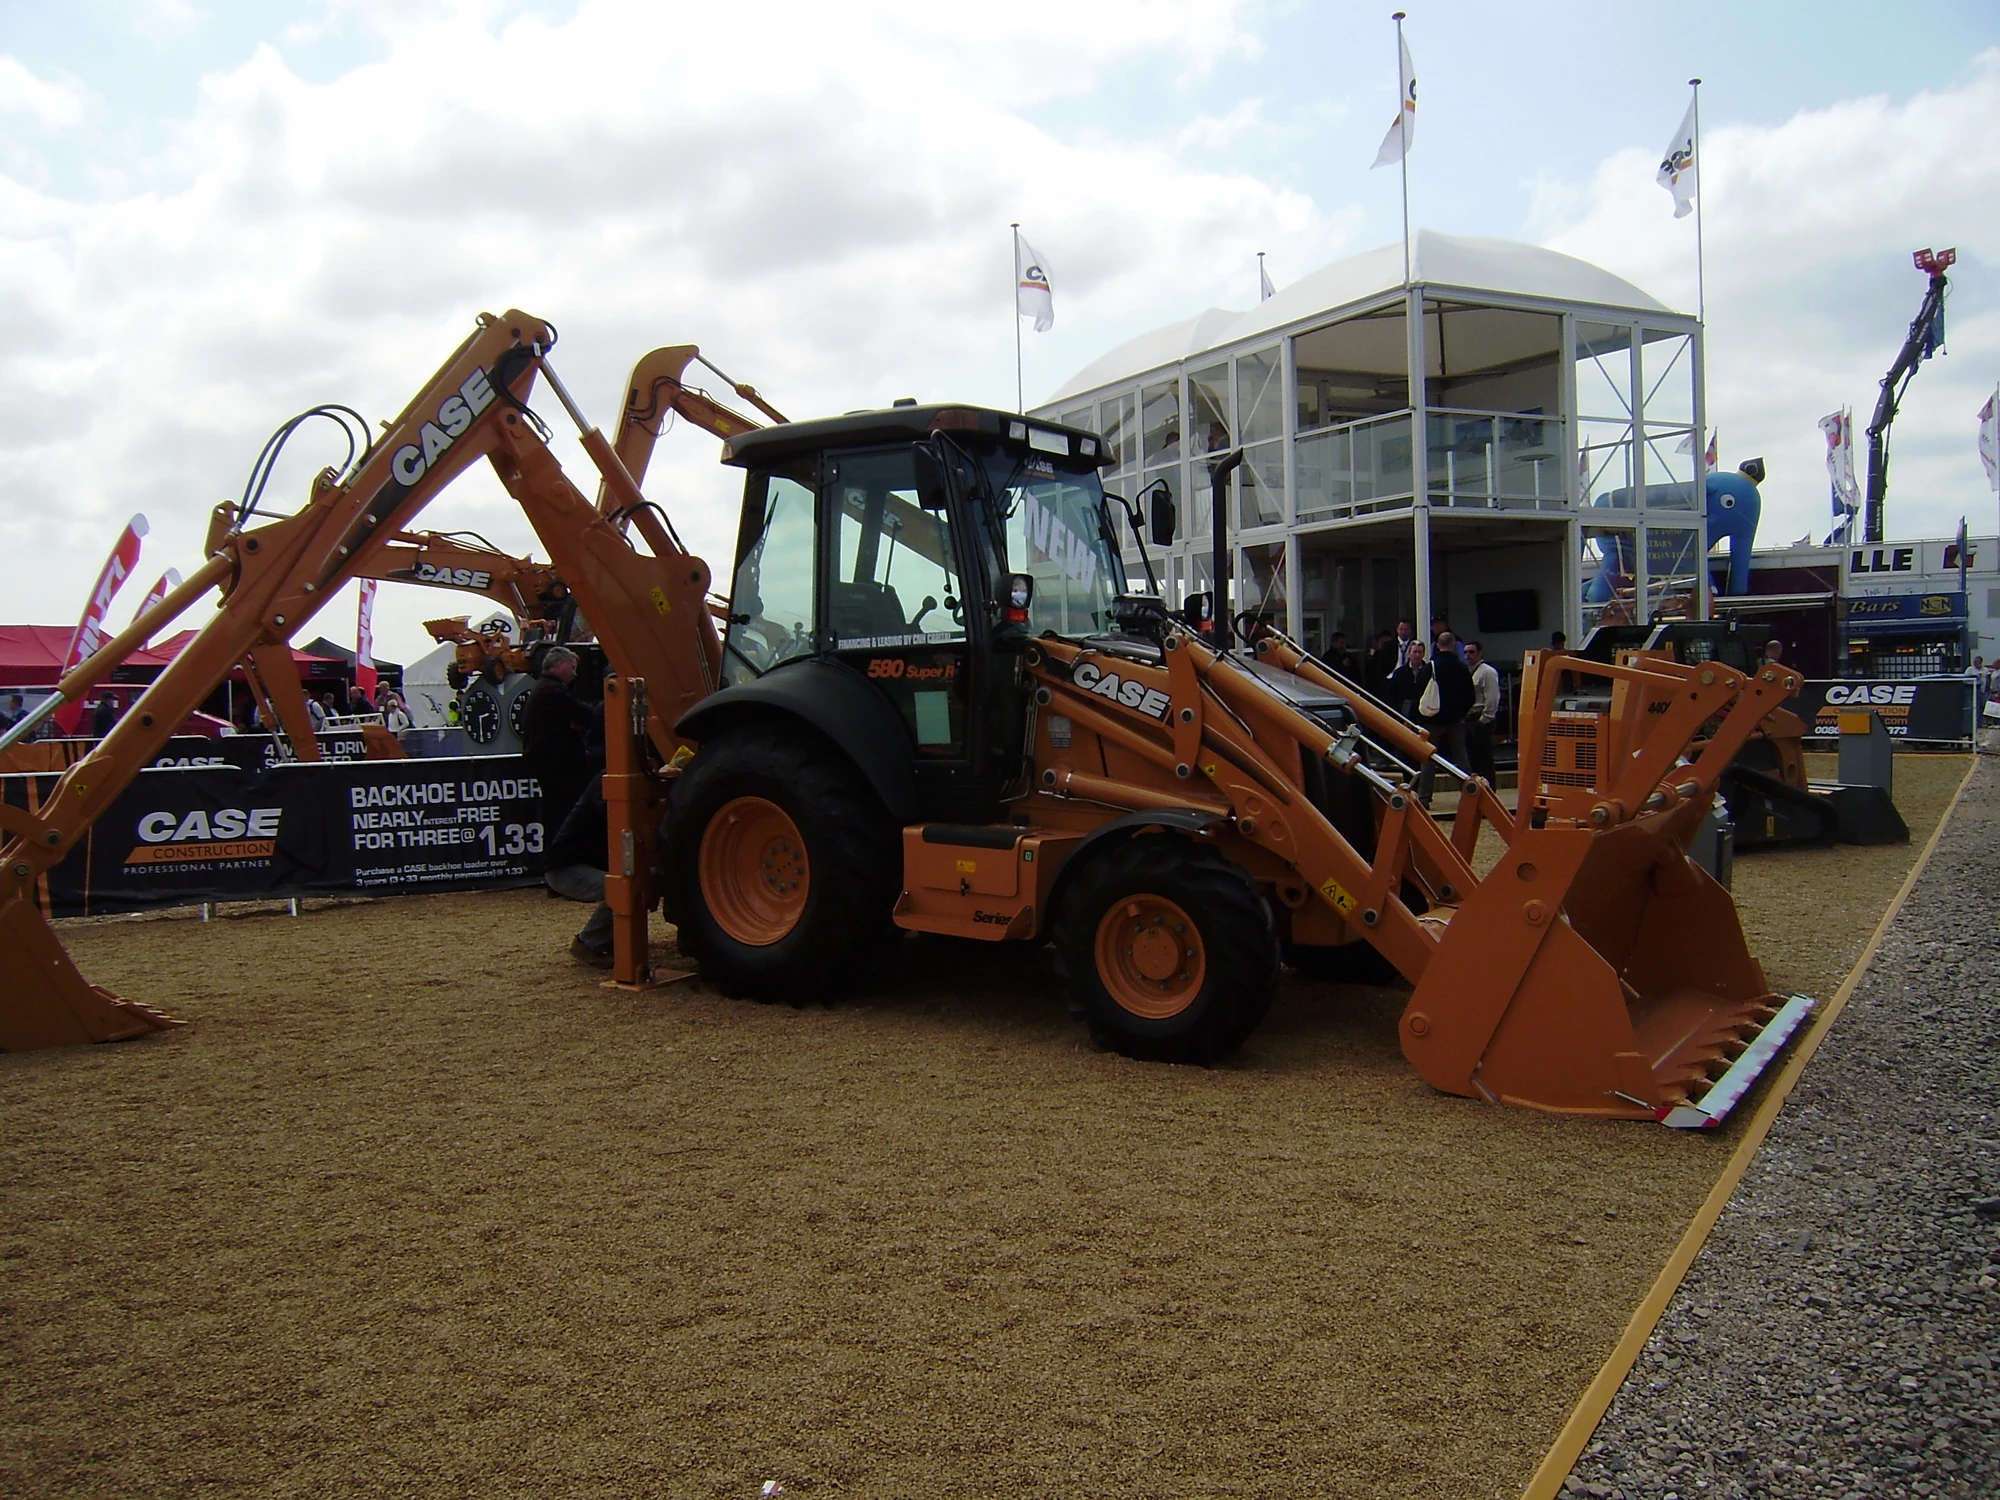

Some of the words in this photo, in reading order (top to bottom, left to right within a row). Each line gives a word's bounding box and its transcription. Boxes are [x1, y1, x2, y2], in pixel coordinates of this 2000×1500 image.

[392, 367, 496, 486] CASE
[1024, 492, 1097, 594] NEW
[417, 564, 491, 589] CASE
[1849, 601, 1900, 613] Bars
[838, 638, 871, 649] FINANCING
[877, 635, 903, 647] LEASING
[867, 659, 905, 678] 580
[906, 665, 943, 679] Super
[1073, 663, 1171, 718] CASE
[1825, 685, 1917, 705] CASE
[334, 741, 368, 754] DRIV
[351, 783, 455, 808] BACKHOE
[461, 778, 543, 802] LOADER
[138, 808, 283, 843] CASE
[353, 810, 425, 829] NEARLY
[423, 817, 458, 826] INTEREST
[457, 806, 500, 823] FREE
[354, 833, 395, 850] FOR
[479, 822, 545, 856] 1.33
[153, 843, 270, 859] CONSTRUCTION
[124, 863, 213, 875] PROFESSIONAL
[219, 860, 271, 870] PARTNER
[355, 867, 395, 877] Purchase
[403, 863, 427, 873] CASE
[428, 862, 462, 872] backhoe
[463, 860, 489, 869] loader
[490, 860, 508, 868] over
[356, 878, 363, 886] 3
[363, 877, 388, 888] years
[406, 874, 418, 883] 33
[420, 871, 453, 883] monthly
